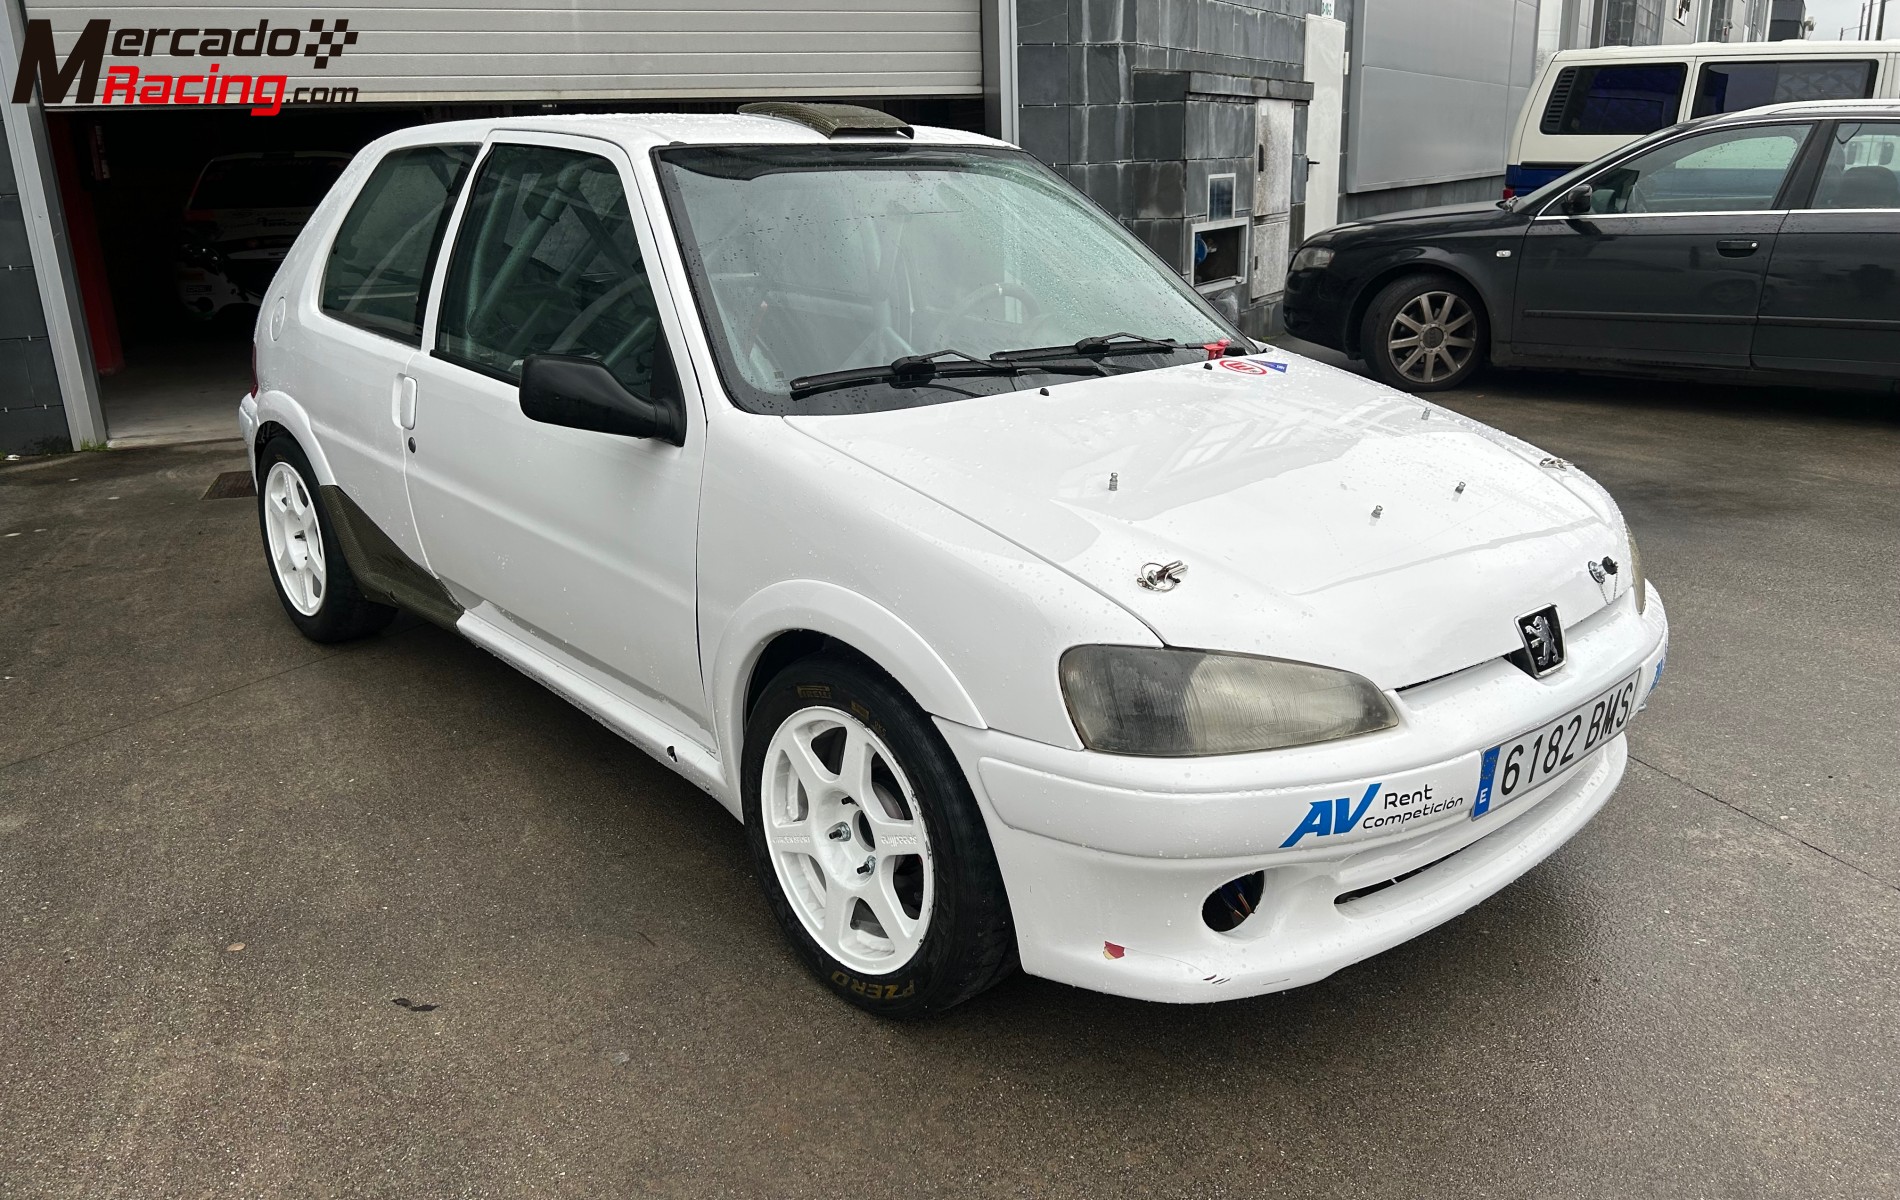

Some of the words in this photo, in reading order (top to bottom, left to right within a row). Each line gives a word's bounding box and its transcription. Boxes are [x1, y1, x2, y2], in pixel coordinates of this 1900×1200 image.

[1501, 714, 1582, 796] 6182
[1583, 681, 1634, 752] BMS
[1278, 782, 1382, 848] AV
[1384, 783, 1433, 809] Rent
[1362, 796, 1464, 830] Competición
[1479, 786, 1488, 804] E
